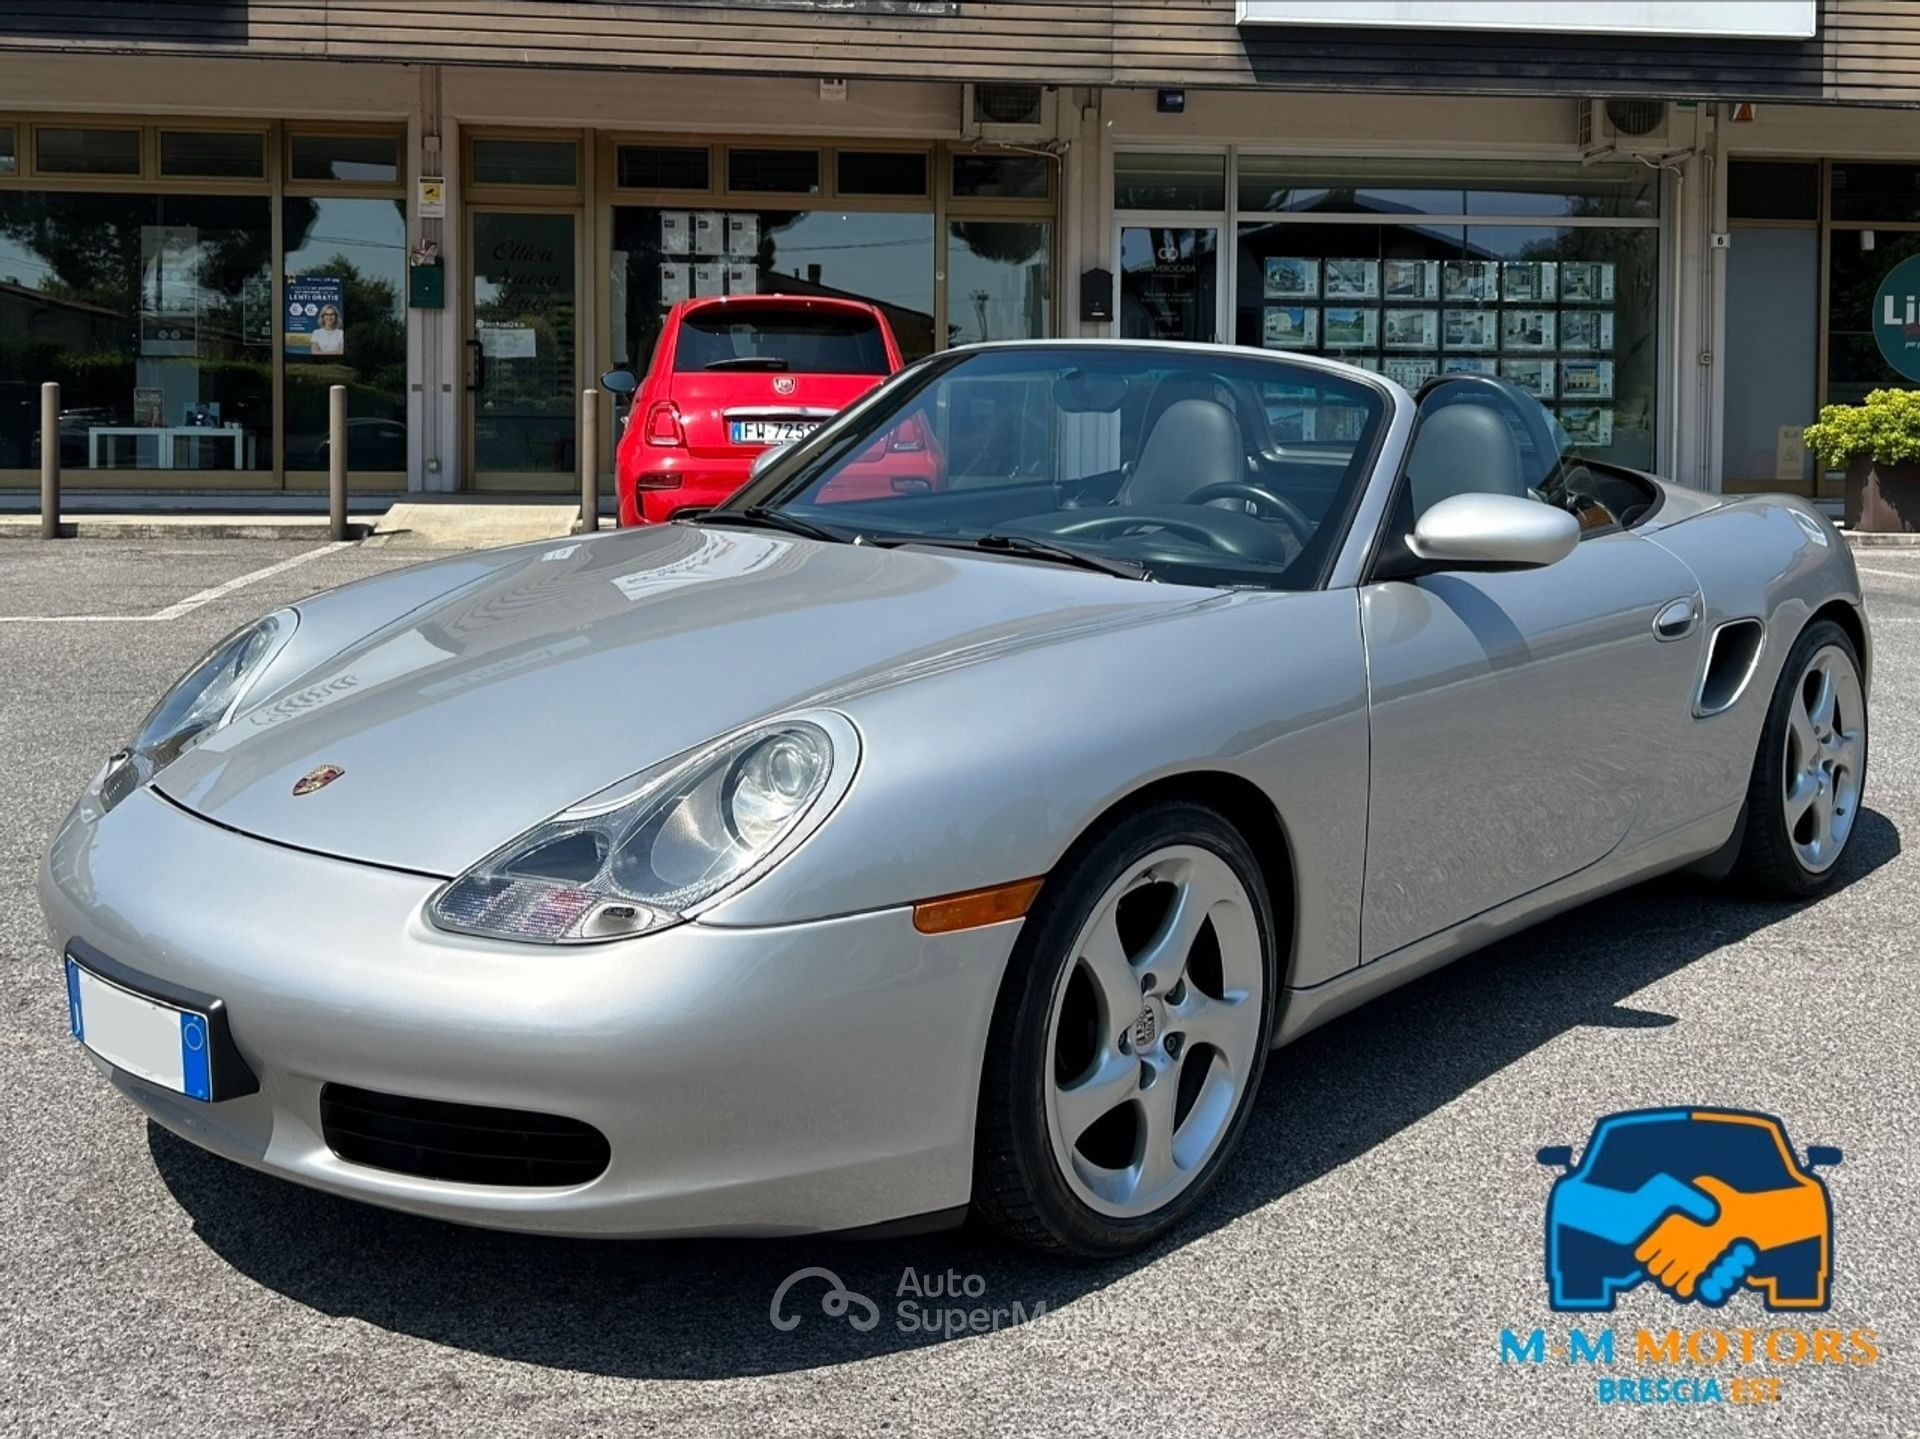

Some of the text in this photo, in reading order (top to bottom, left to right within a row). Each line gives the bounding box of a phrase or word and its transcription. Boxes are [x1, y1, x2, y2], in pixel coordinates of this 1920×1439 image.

[288, 293, 339, 301] LENTI GRATIS
[1884, 295, 1920, 325] Li
[744, 422, 766, 439] FW
